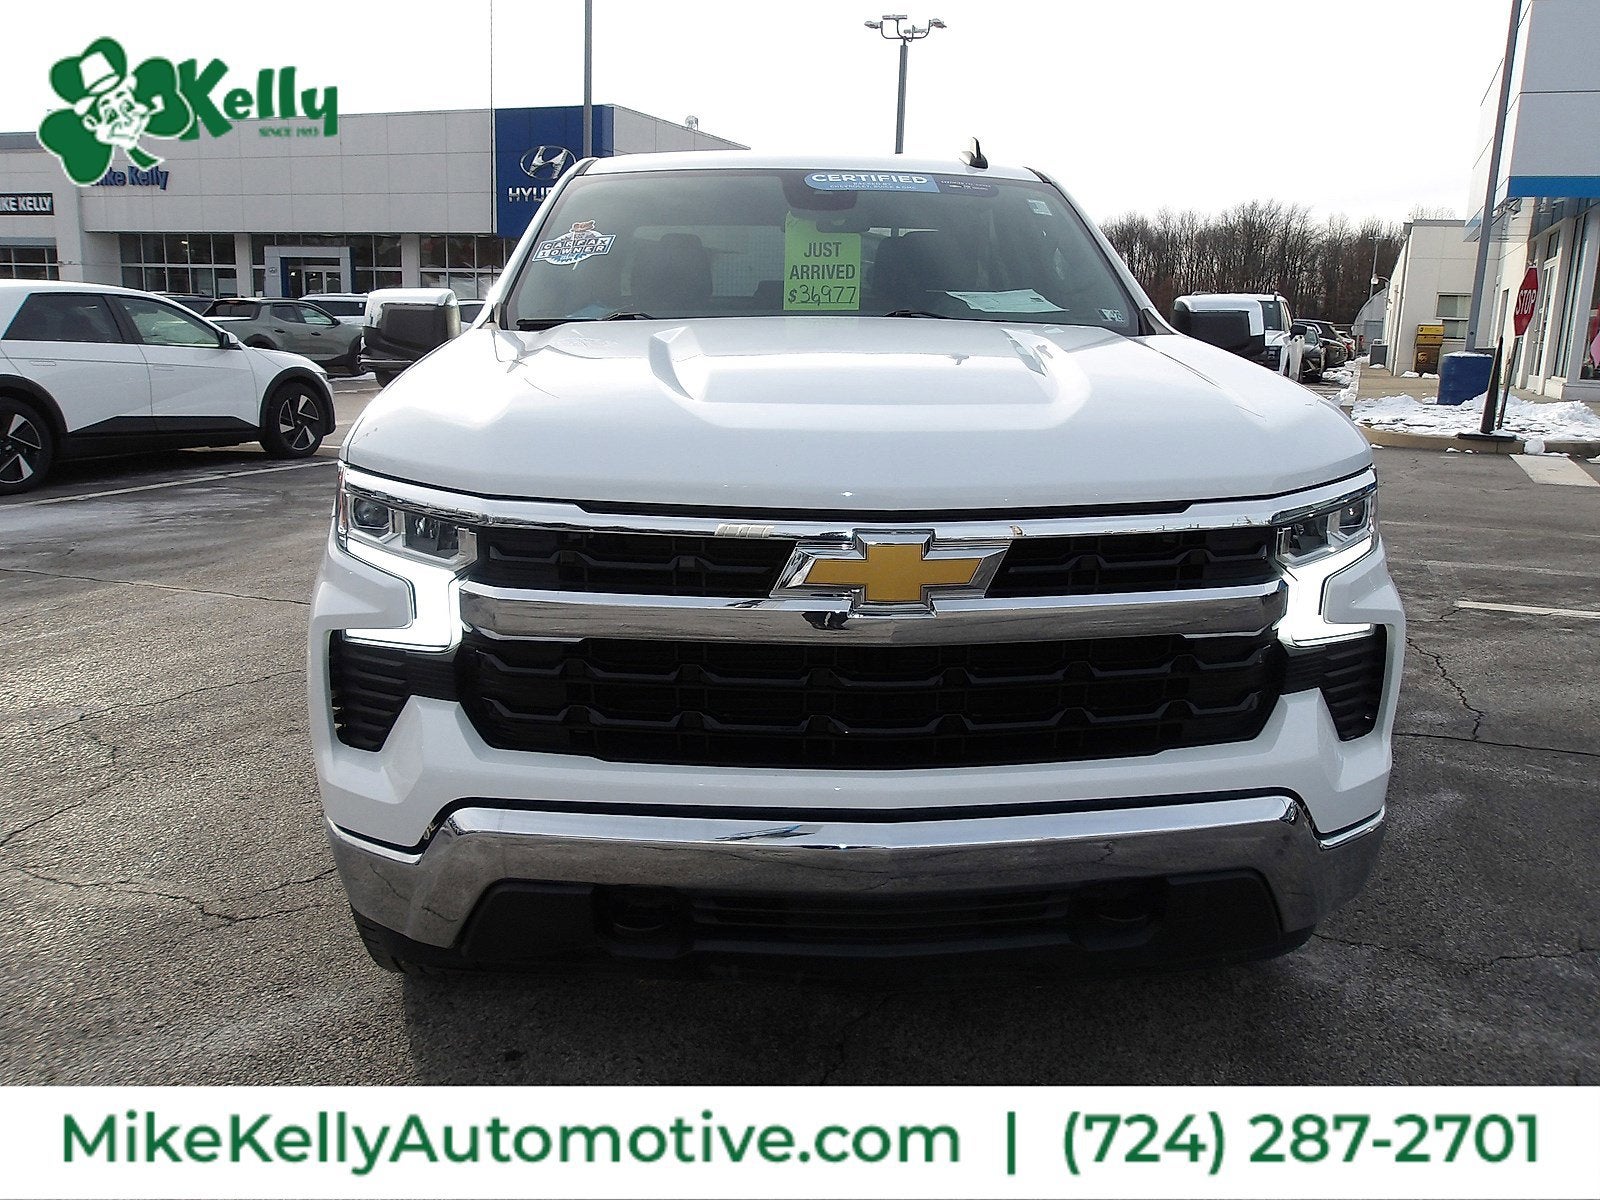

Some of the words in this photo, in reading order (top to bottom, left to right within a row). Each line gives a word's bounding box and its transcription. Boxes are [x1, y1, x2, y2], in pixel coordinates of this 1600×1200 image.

[91, 167, 127, 186] ike
[128, 165, 169, 190] Kelly
[811, 174, 928, 184] CERTIFIED
[18, 196, 51, 211] KELLY
[543, 239, 608, 250] CARFAX
[550, 245, 605, 256] OWNER
[803, 241, 842, 258] JUST
[789, 264, 856, 280] ARRIVED
[1515, 289, 1537, 316] STOP
